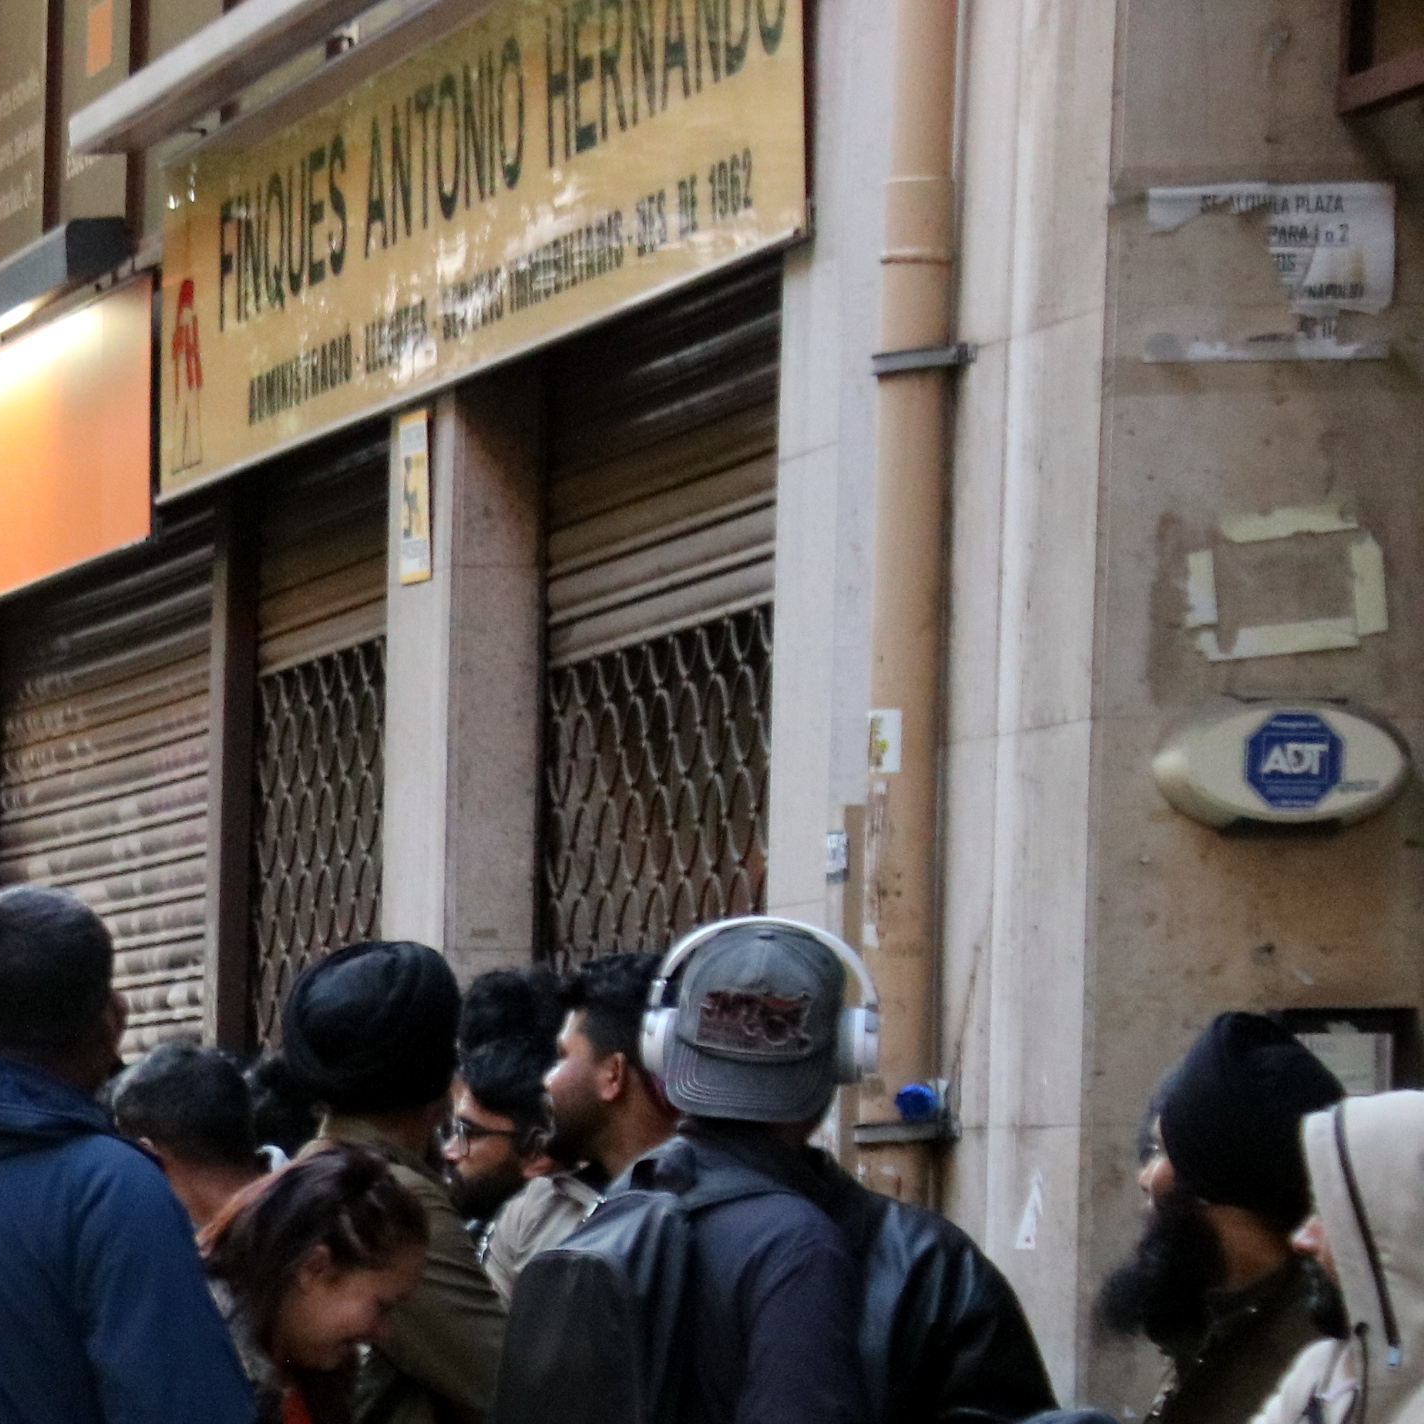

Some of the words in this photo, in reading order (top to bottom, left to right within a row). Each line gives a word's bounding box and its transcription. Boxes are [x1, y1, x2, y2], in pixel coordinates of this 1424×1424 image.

[219, 132, 348, 334] FINQUES
[363, 36, 524, 260] ANTONIO
[708, 147, 753, 223] 1962
[1295, 193, 1345, 215] PLAZA
[1338, 223, 1350, 243] 2
[1261, 741, 1330, 776] ADT
